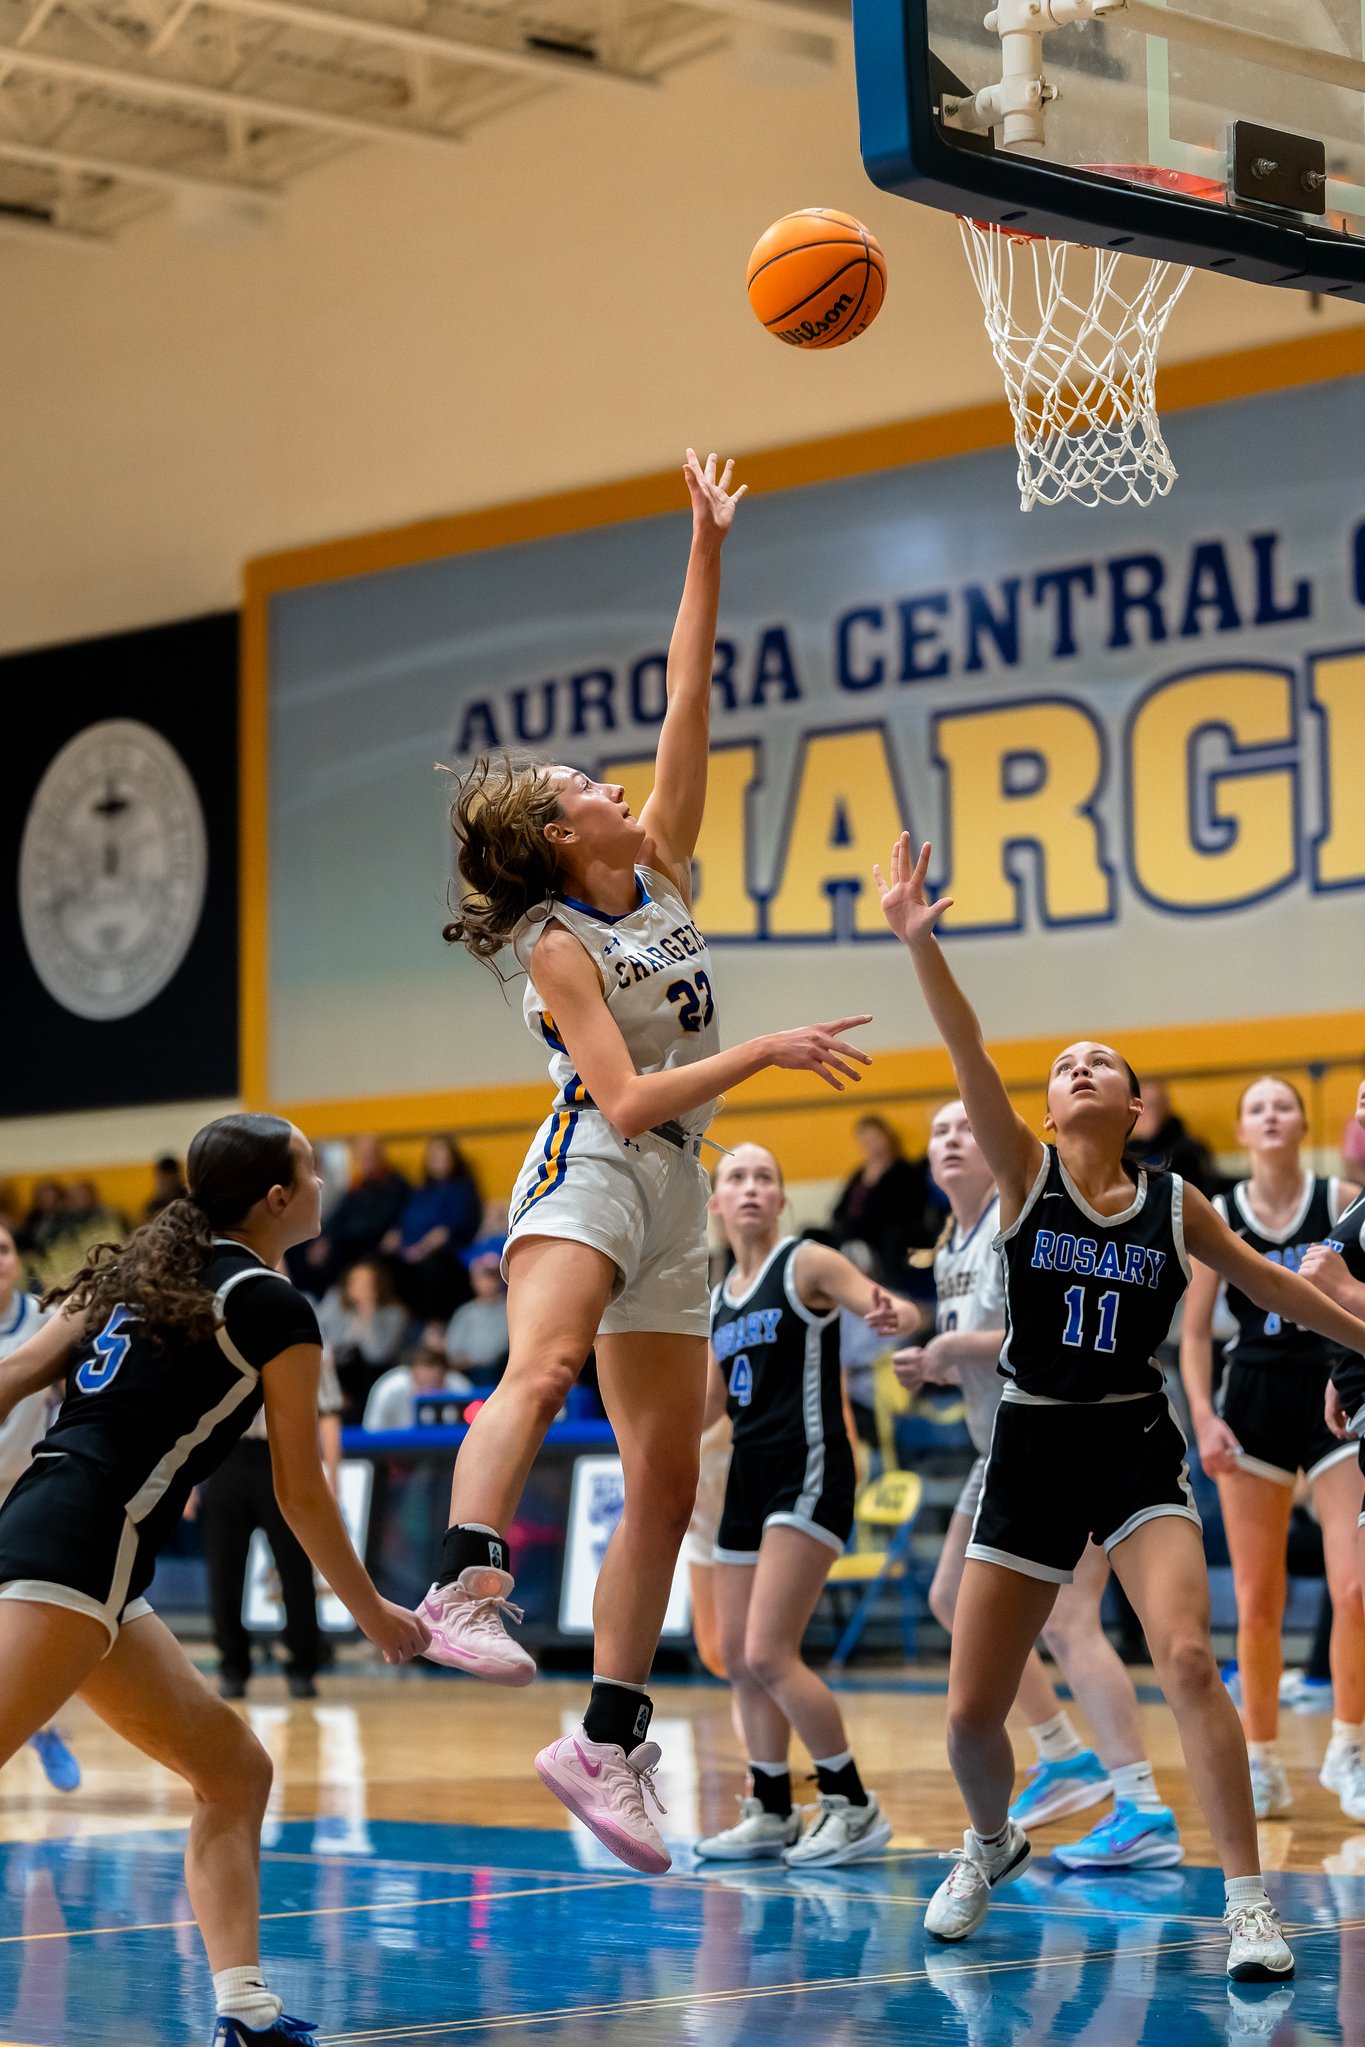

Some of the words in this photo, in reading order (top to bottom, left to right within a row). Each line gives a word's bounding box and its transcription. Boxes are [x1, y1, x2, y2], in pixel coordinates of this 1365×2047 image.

[775, 293, 854, 345] Wilson
[834, 530, 1312, 692] CENTRAL
[452, 648, 1365, 945] HARG
[1031, 1229, 1166, 1289] ROSARY
[75, 1302, 146, 1394] 5
[1062, 1285, 1120, 1353] 11
[729, 1353, 753, 1407] 4
